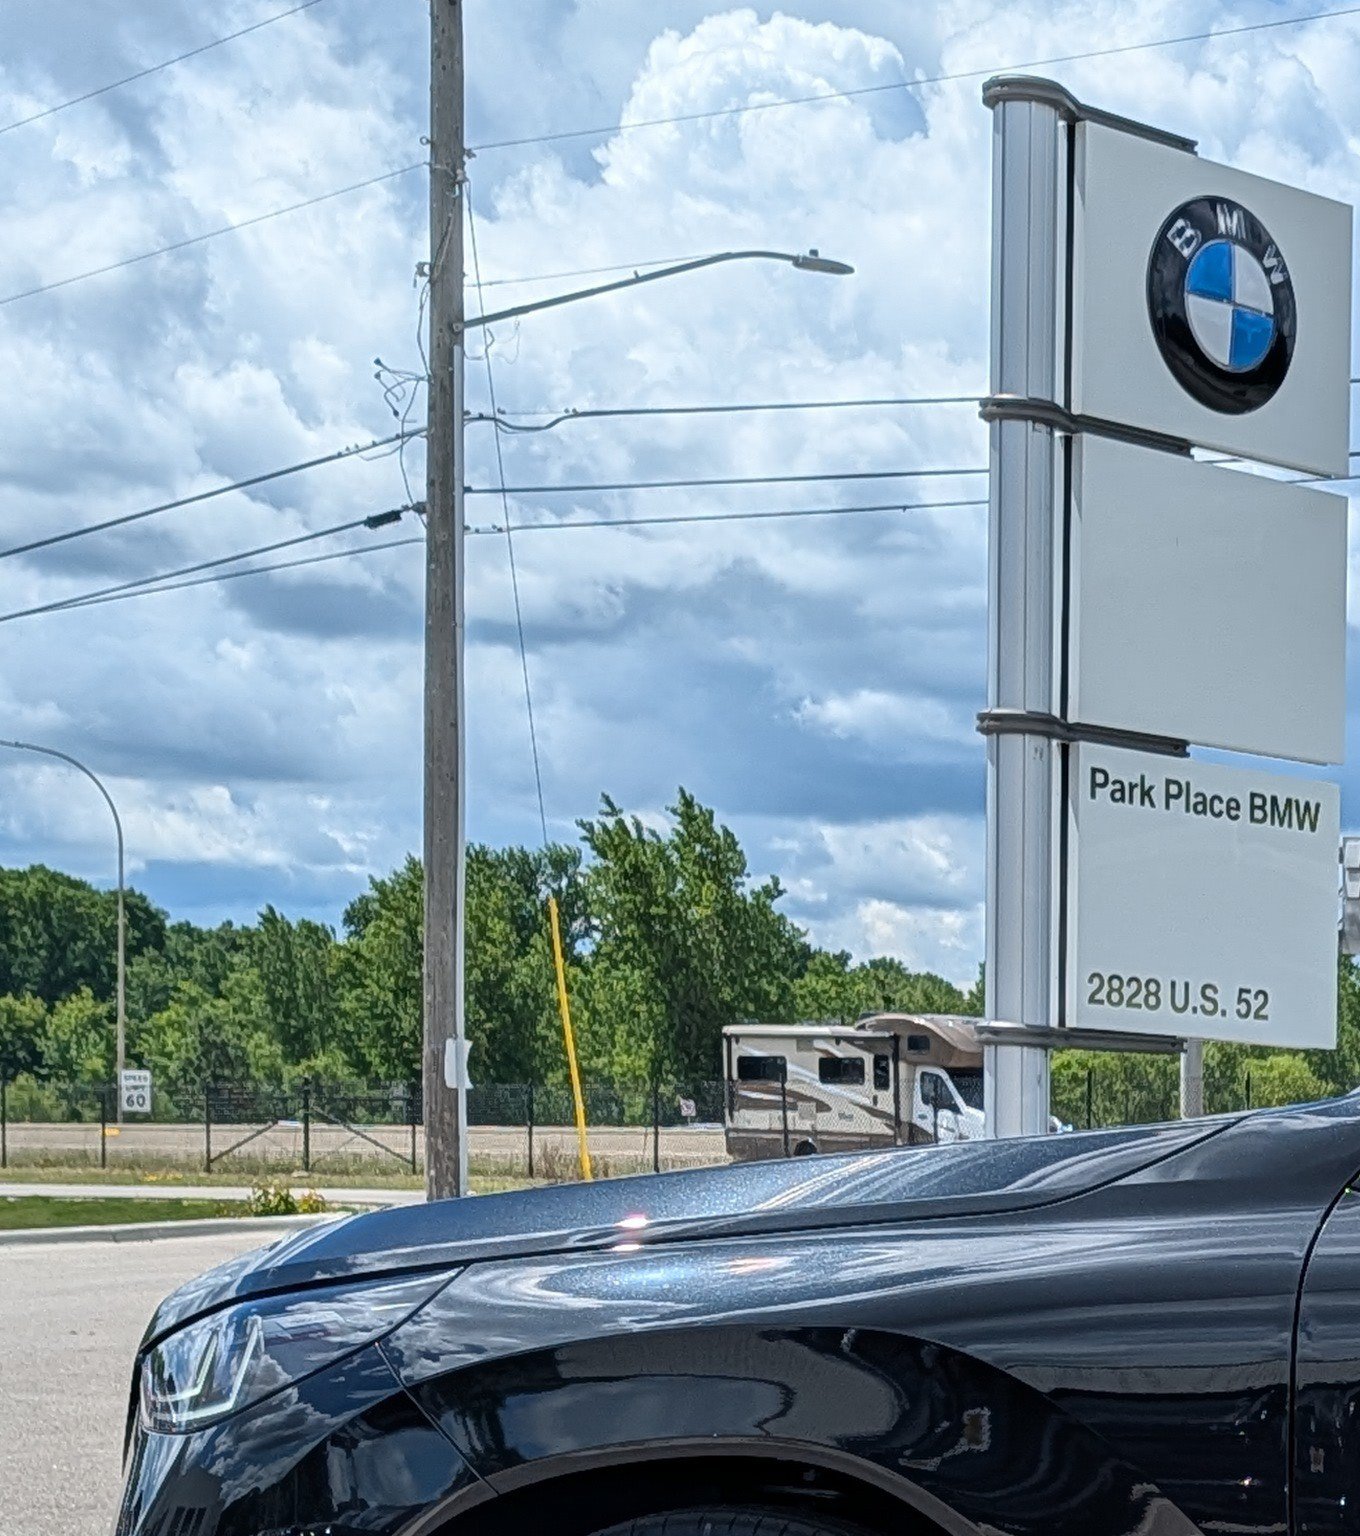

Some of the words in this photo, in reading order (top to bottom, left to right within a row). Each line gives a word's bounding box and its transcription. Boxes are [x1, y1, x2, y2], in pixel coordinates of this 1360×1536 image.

[1166, 202, 1290, 286] BMW
[1089, 766, 1156, 809] Park
[1164, 777, 1241, 821] Place
[1249, 791, 1321, 833] BMW
[1087, 972, 1162, 1012] 2828
[1170, 979, 1227, 1018] U.S.
[1235, 987, 1269, 1022] 52
[125, 1093, 146, 1108] 60
